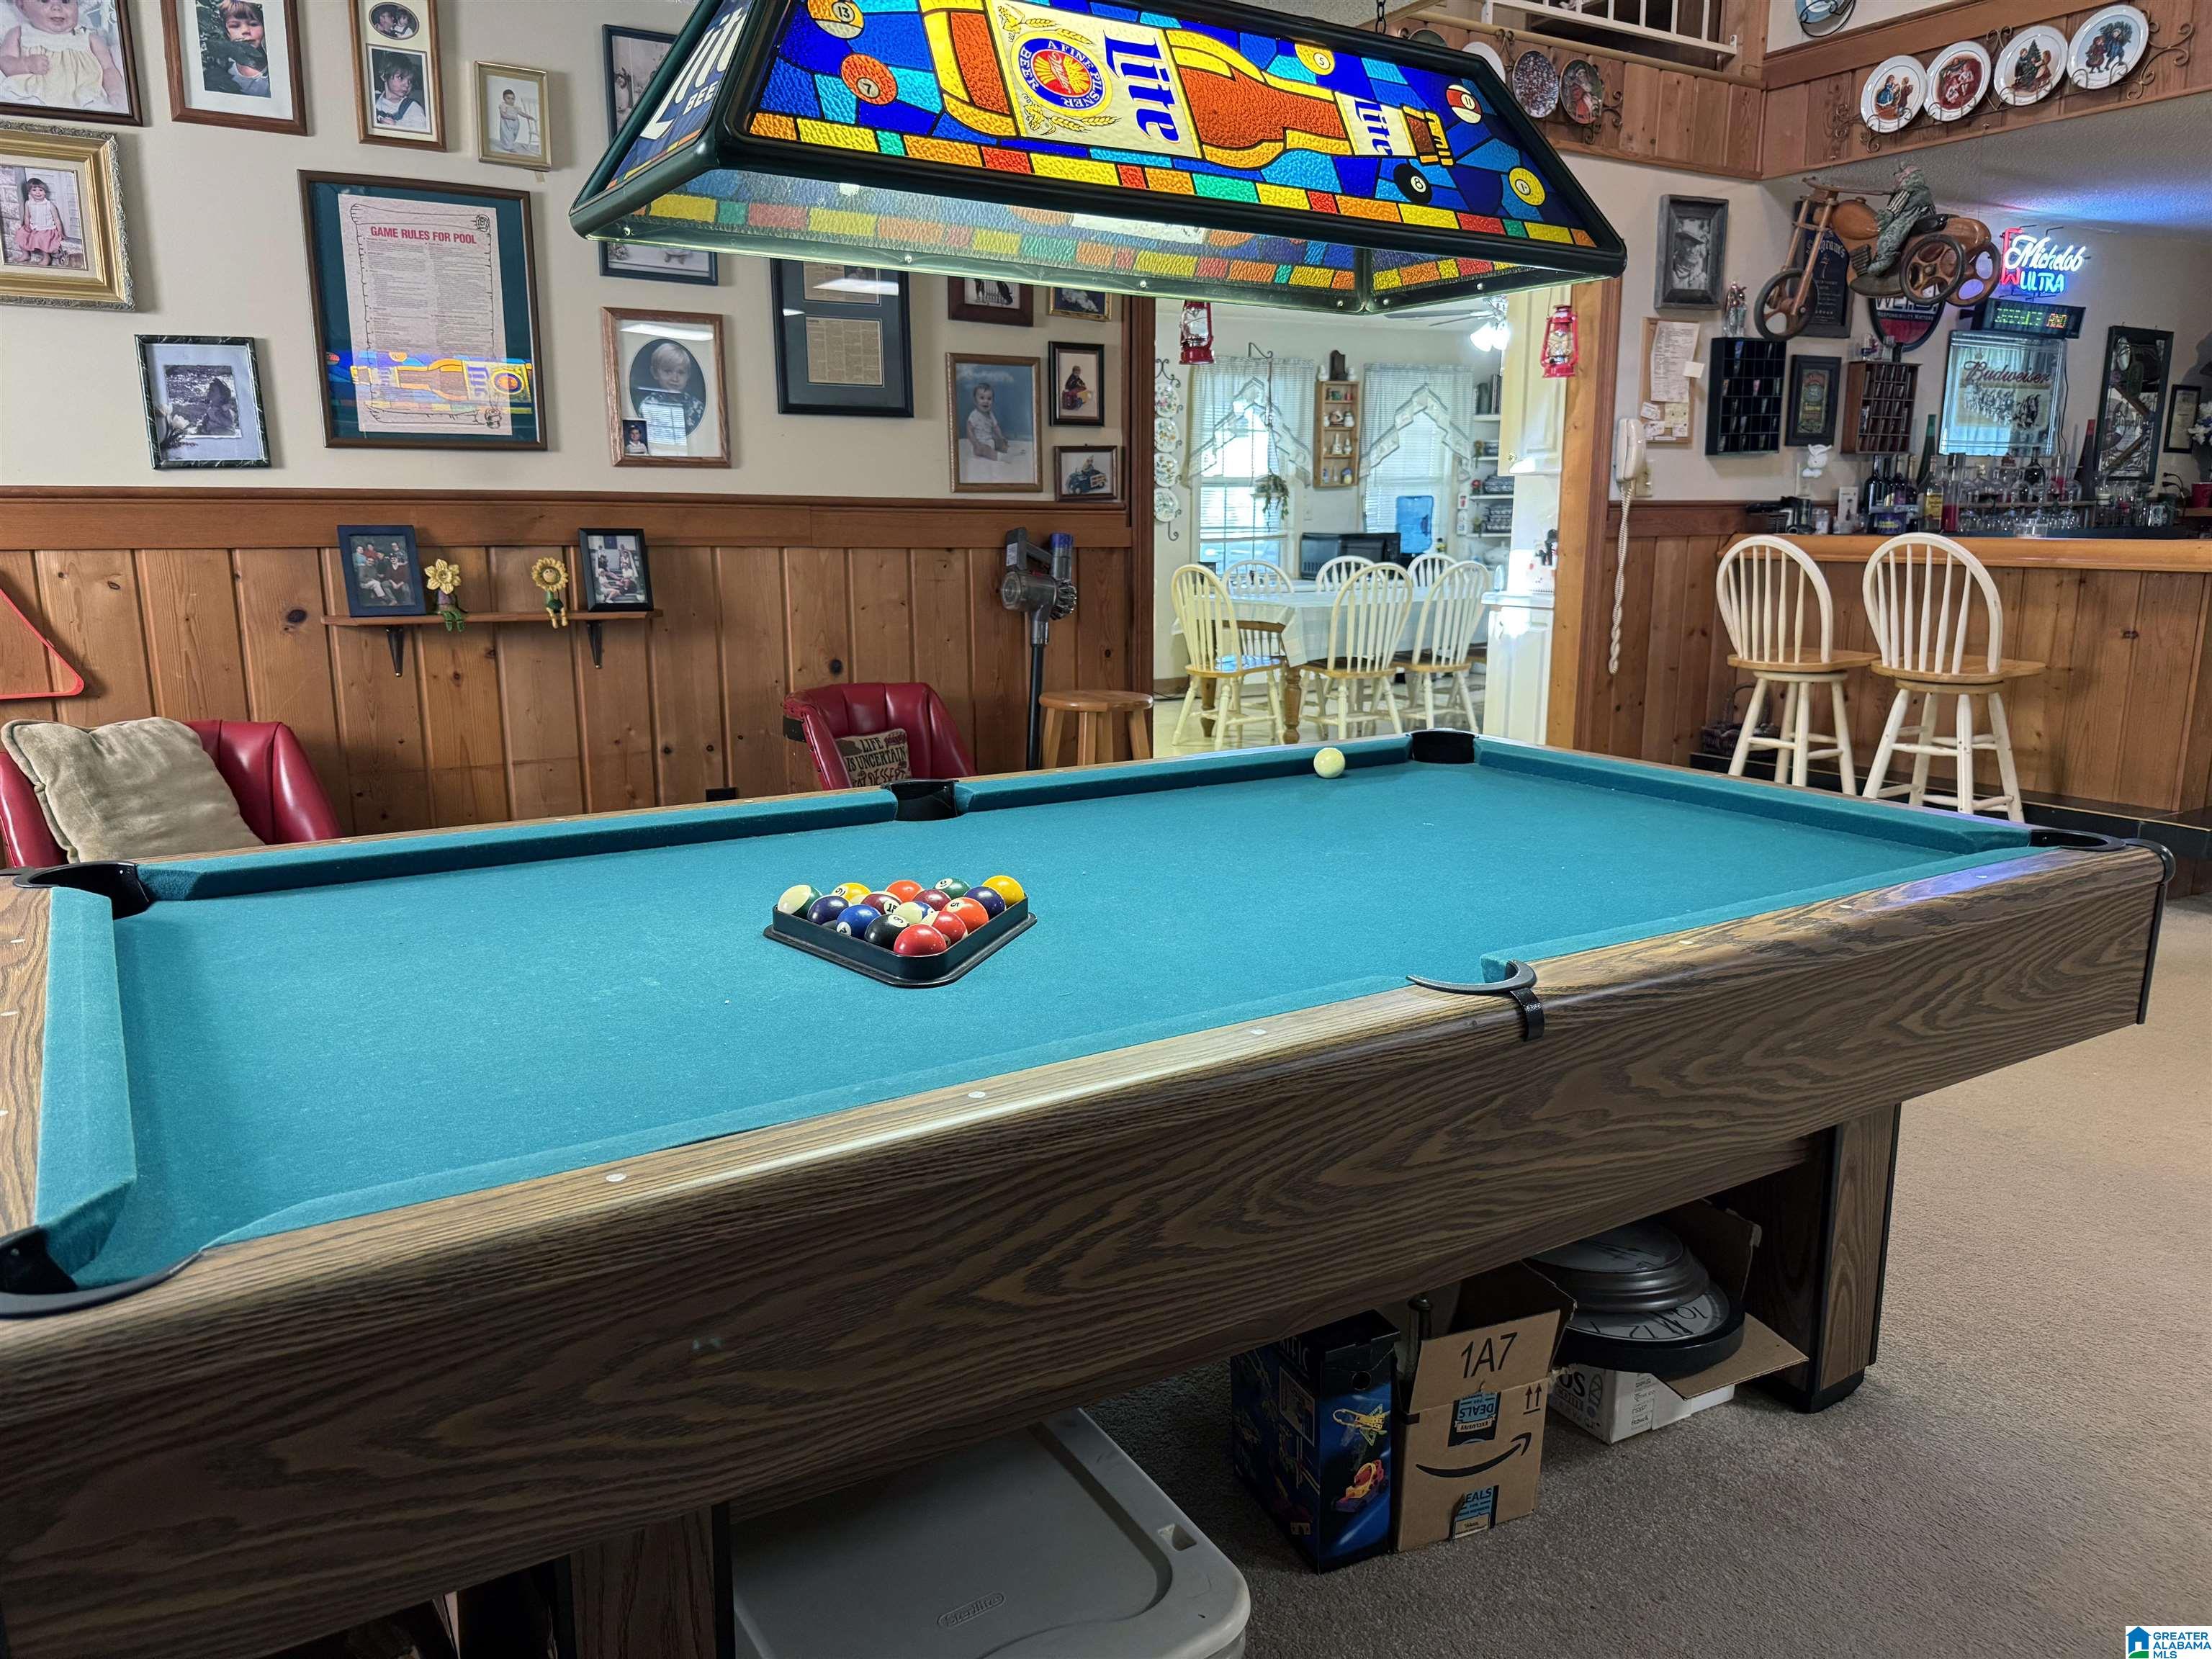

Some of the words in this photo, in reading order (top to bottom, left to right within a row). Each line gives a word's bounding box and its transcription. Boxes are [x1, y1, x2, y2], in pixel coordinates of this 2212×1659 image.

[837, 6, 850, 19] 13
[1047, 40, 1058, 50] A
[1061, 42, 1094, 70] FINE
[1020, 46, 1040, 91] BEER
[683, 81, 719, 115] BEE
[863, 82, 872, 95] 7
[1061, 71, 1103, 108] PILSNER
[1102, 30, 1181, 142] Lite
[1354, 99, 1393, 156] Lite
[1414, 177, 1424, 189] 8
[371, 226, 399, 238] GAME
[401, 229, 431, 240] RULES
[433, 232, 451, 243] FOR
[454, 234, 477, 245] POOL
[2004, 234, 2087, 272] Michelob
[2020, 271, 2065, 293] ULTRA
[1963, 360, 2051, 385] Budweiser
[860, 737, 884, 752] LIFE
[846, 757, 857, 772] IS
[855, 746, 907, 770] UNCERTAIN
[1461, 1332, 1518, 1379] 1A7
[1459, 1403, 1496, 1419] DEALS
[1465, 1487, 1493, 1503] EALS
